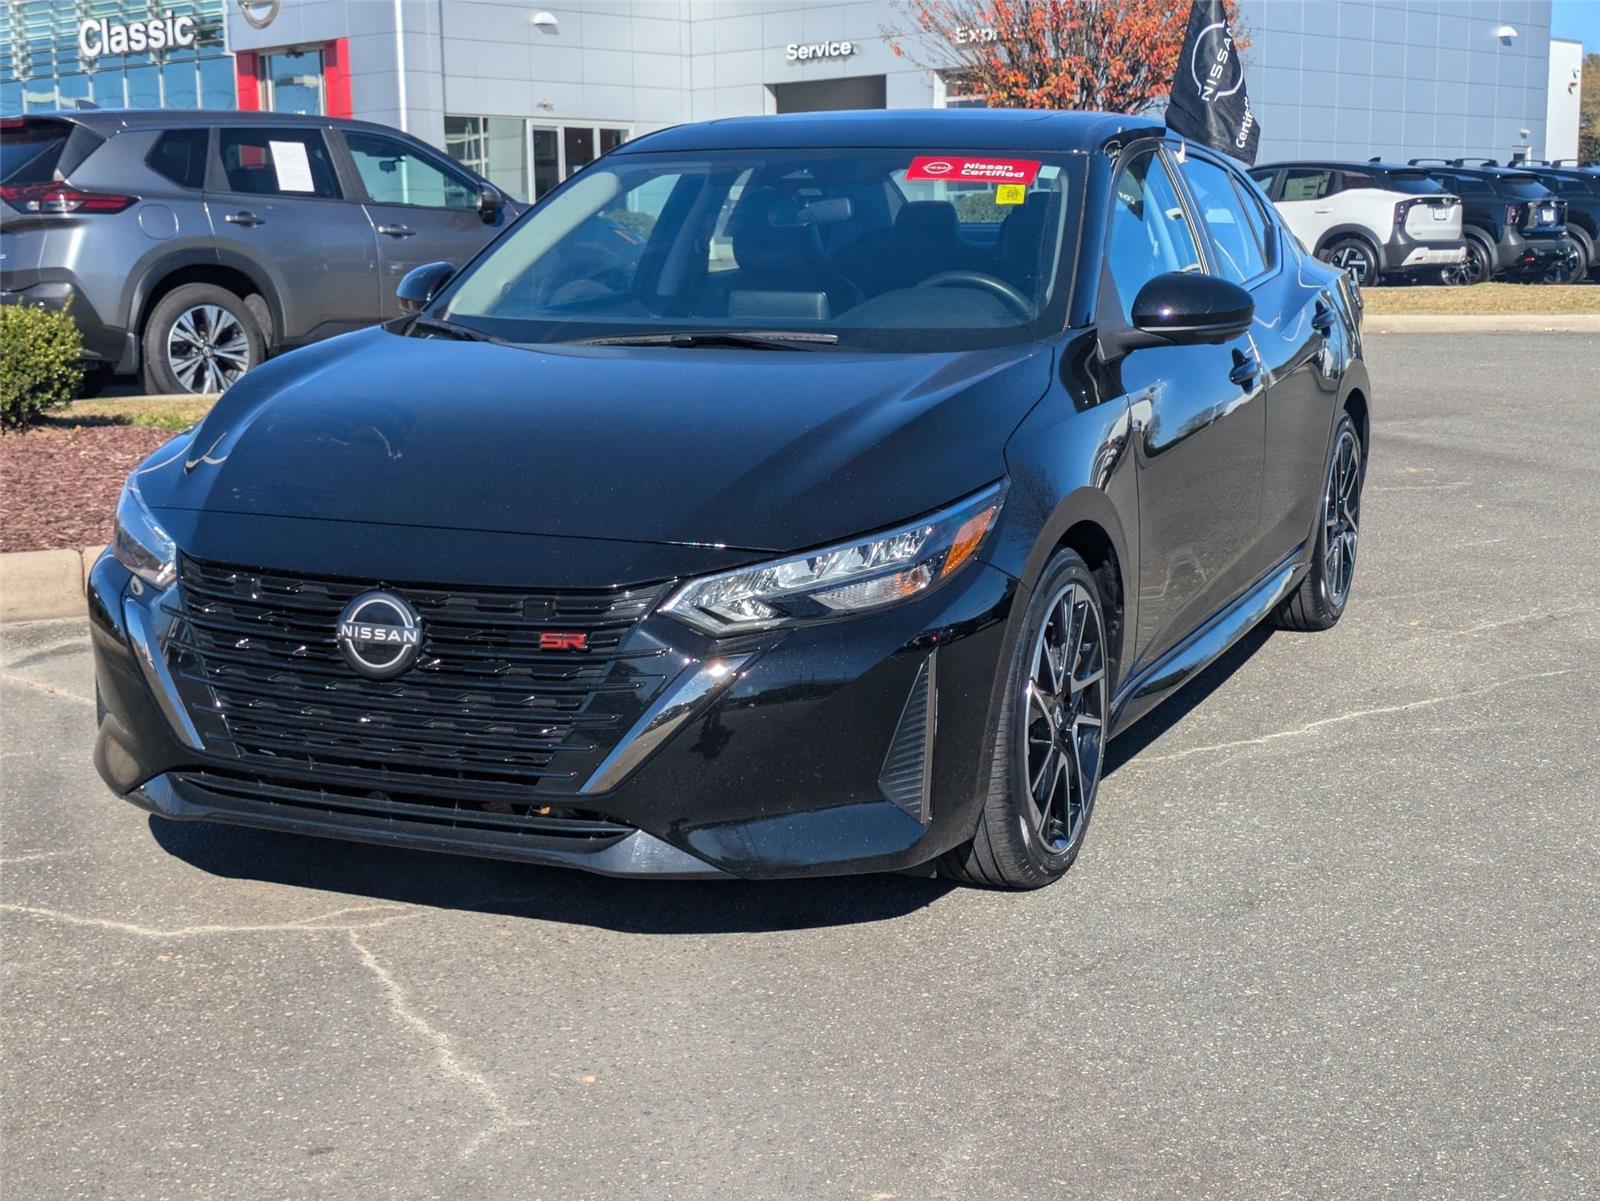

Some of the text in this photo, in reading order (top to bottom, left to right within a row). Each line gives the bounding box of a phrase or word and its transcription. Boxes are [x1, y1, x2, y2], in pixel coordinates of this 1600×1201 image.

[79, 9, 195, 57] Classic
[786, 40, 852, 60] Service
[960, 169, 1025, 178] Certified
[963, 162, 1014, 172] Nissan
[341, 624, 417, 643] NISSAN
[540, 633, 586, 649] SR
